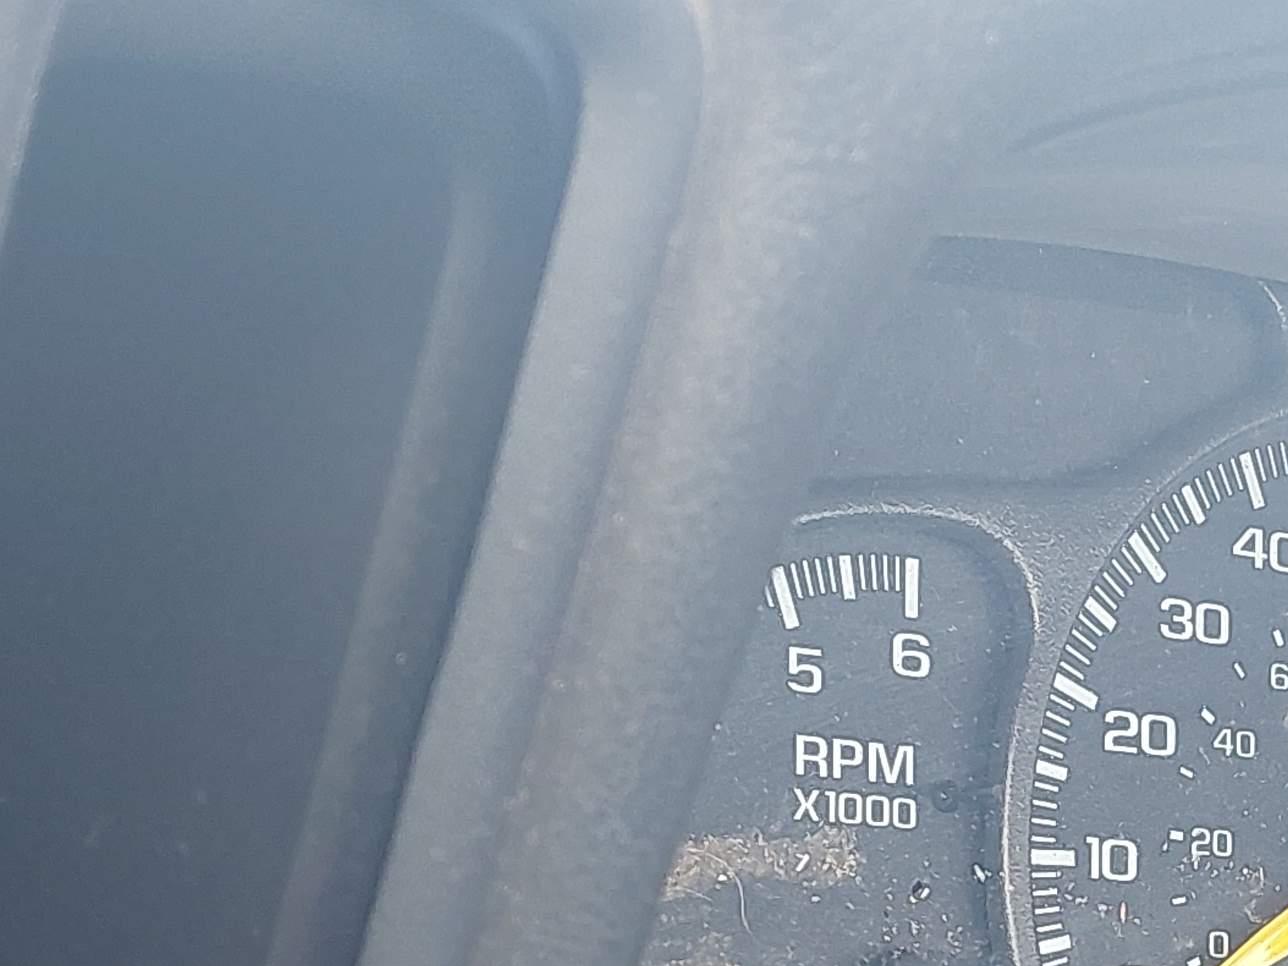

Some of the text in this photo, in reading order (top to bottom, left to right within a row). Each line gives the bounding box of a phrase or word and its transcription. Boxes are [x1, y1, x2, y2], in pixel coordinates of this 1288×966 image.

[1159, 598, 1230, 645] 30
[786, 646, 823, 694] 5
[892, 633, 931, 678] 6
[1103, 710, 1177, 757] 20
[1213, 728, 1256, 758] 40
[795, 734, 915, 786] RPM
[793, 788, 917, 829] X1000
[1086, 836, 1138, 882] 10
[1190, 828, 1233, 857] 20
[1208, 931, 1230, 959] 0
